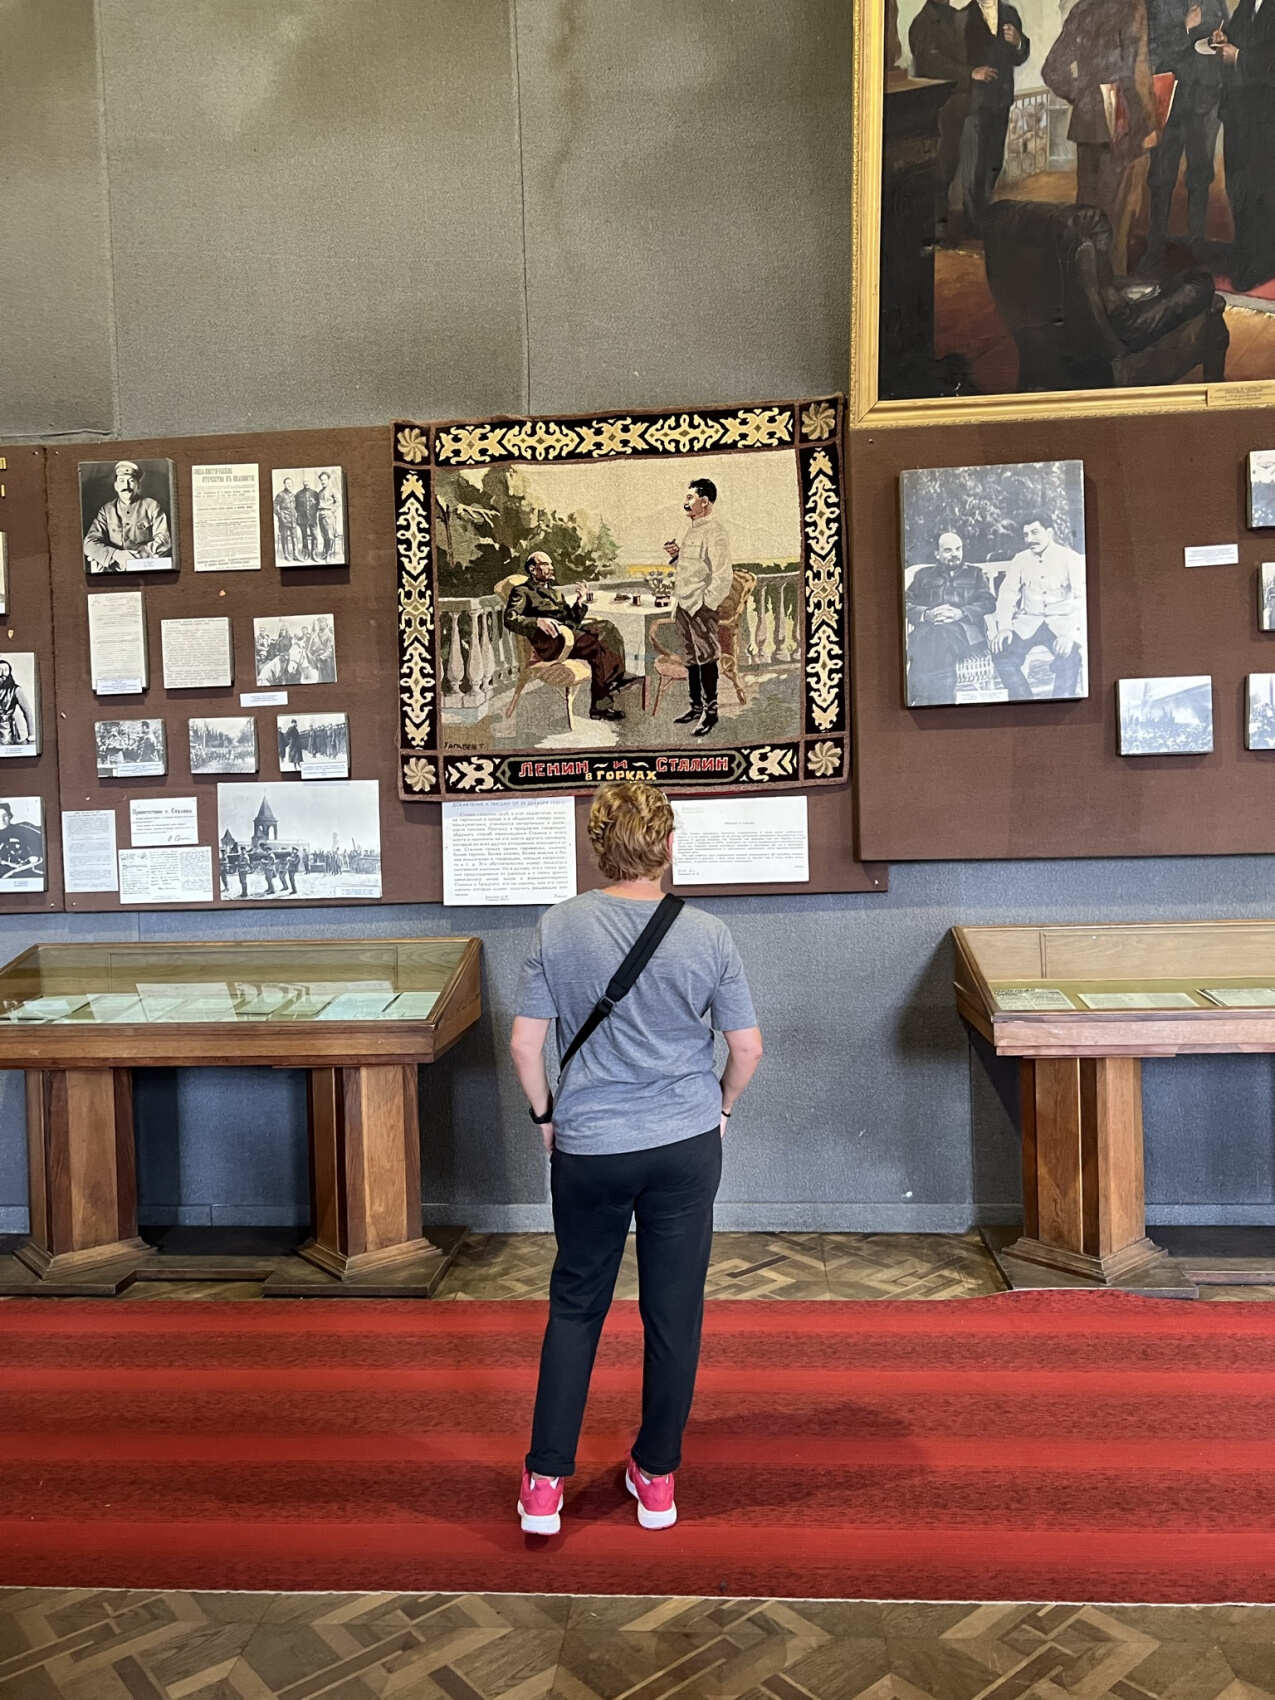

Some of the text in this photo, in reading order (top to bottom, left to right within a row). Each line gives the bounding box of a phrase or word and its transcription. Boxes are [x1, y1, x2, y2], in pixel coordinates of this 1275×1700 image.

[518, 760, 589, 778] ЛЕНИН
[655, 756, 729, 772] СТАЛИН
[596, 770, 657, 781] ГОРКАХ
